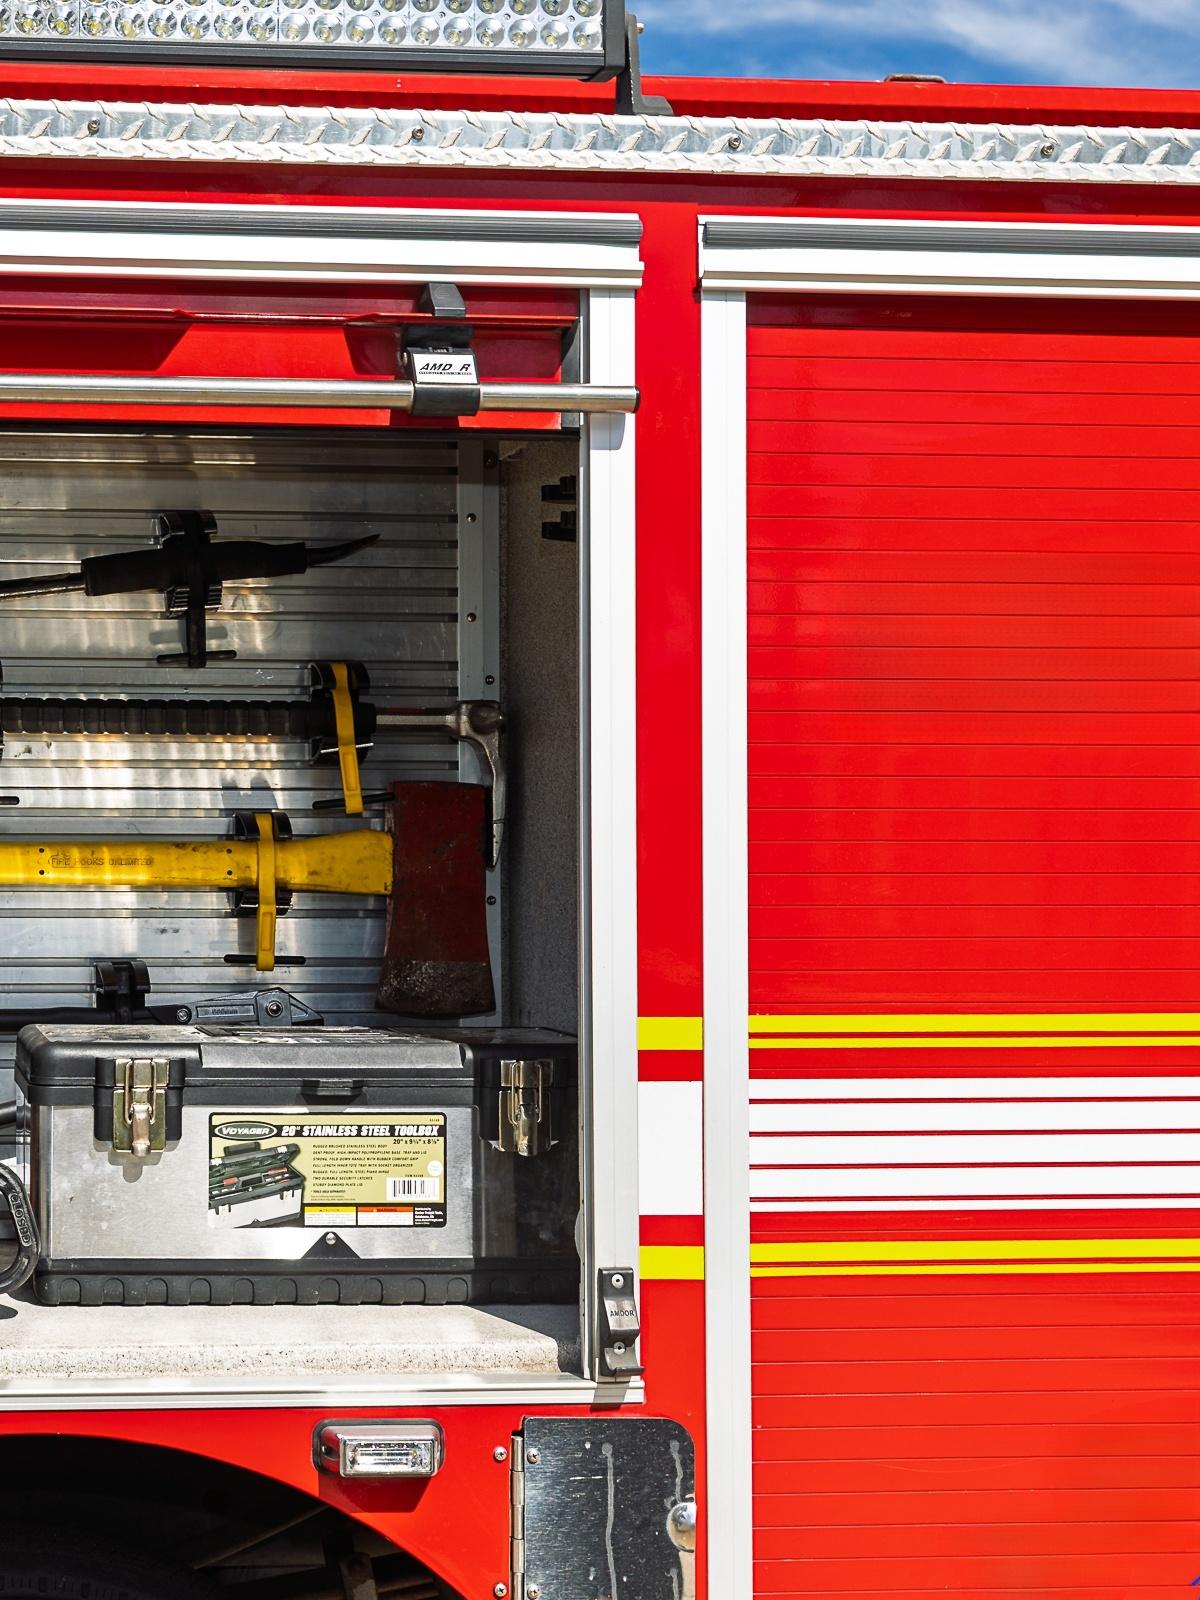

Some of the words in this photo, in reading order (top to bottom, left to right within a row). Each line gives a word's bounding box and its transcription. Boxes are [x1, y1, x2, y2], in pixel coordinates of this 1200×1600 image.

[420, 363, 471, 372] AMDR
[222, 1127, 270, 1135] VOYAGER
[281, 1126, 300, 1136] 20"
[302, 1126, 358, 1136] STAINLESS
[360, 1126, 390, 1136] STEEL
[394, 1126, 439, 1136] TOOLBOX
[10, 1194, 31, 1243] CLOSED
